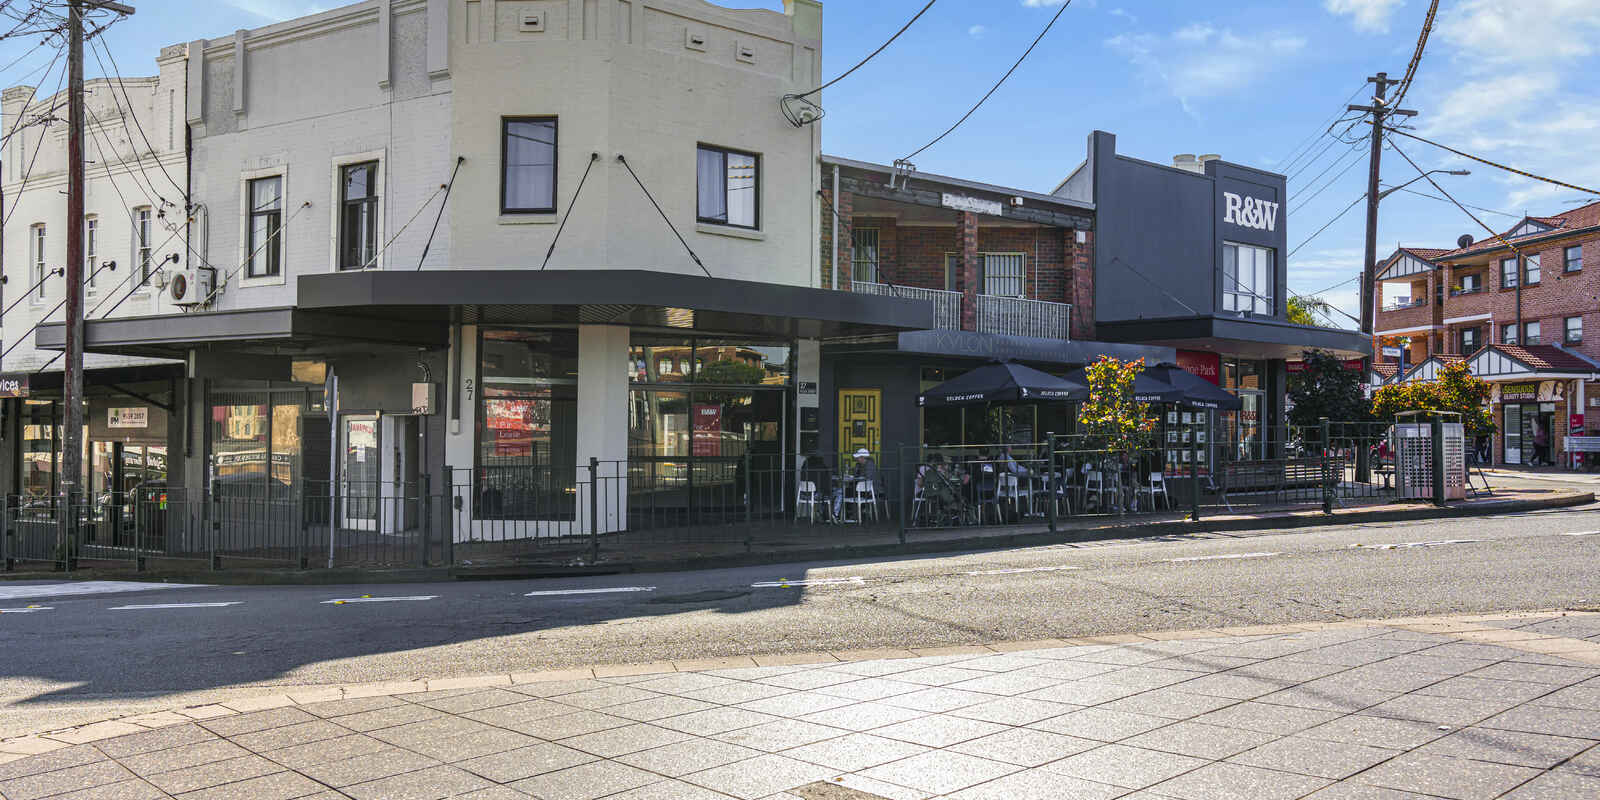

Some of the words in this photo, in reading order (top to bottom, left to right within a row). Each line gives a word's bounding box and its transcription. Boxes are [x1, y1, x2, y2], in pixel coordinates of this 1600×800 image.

[1224, 191, 1279, 231] R&W
[1200, 363, 1216, 376] Park
[1503, 385, 1536, 394] SENSUOUS
